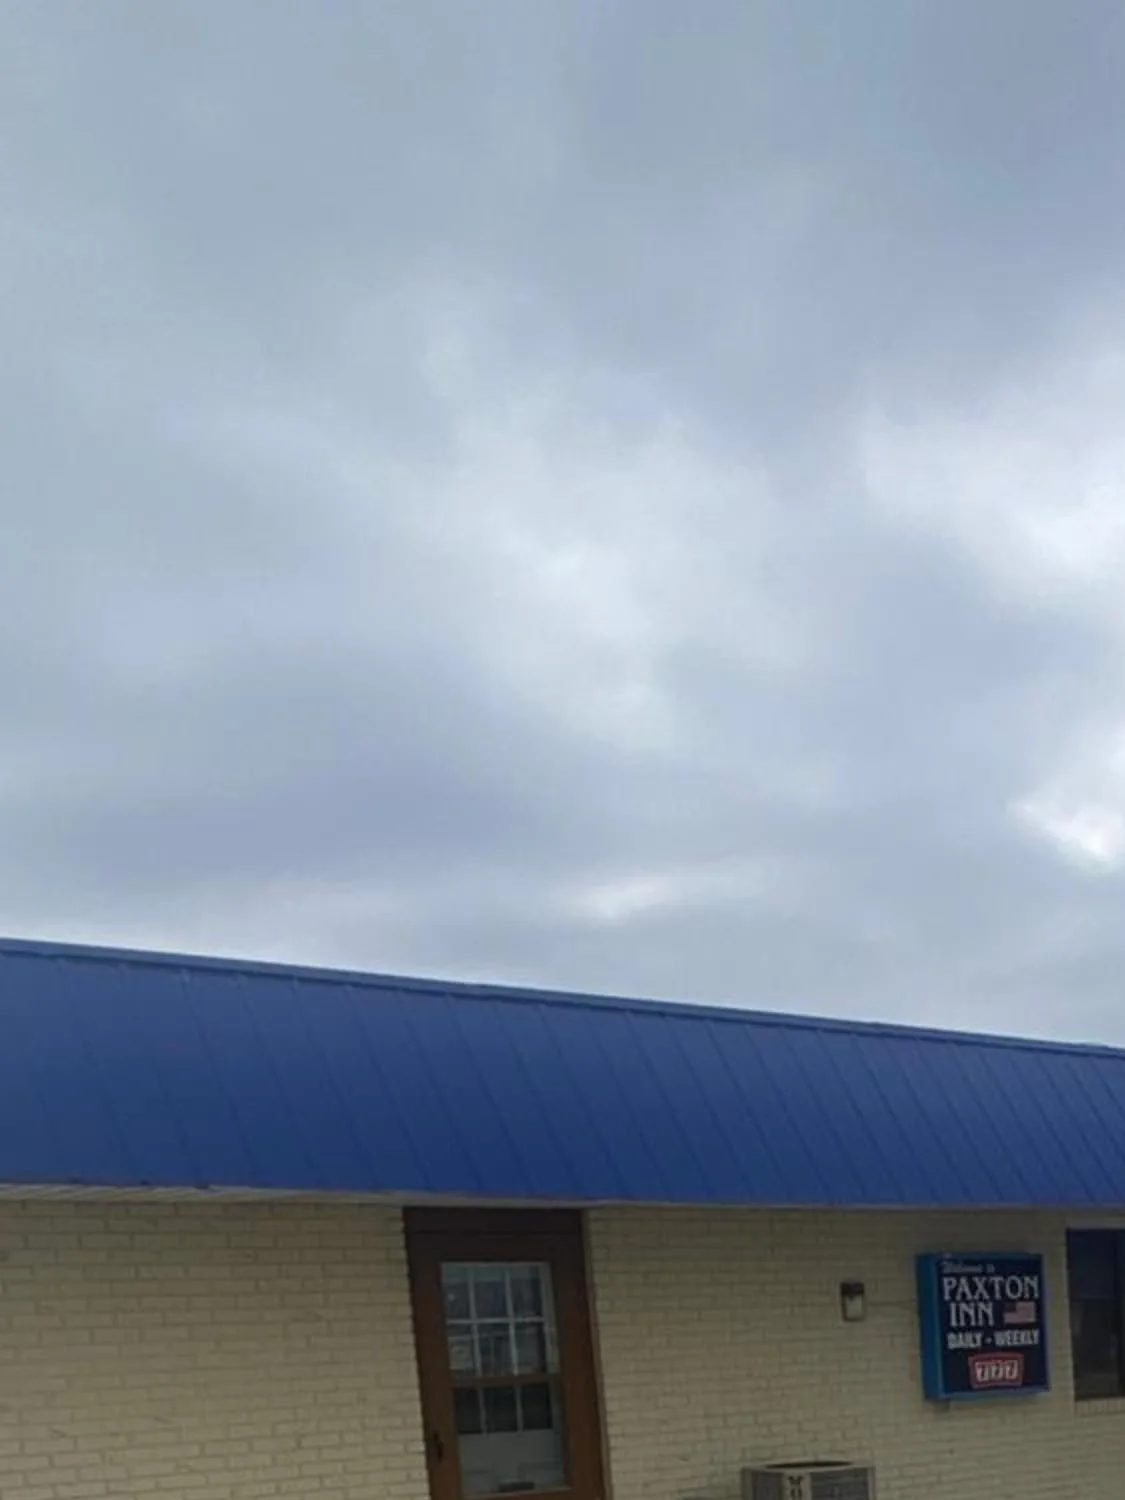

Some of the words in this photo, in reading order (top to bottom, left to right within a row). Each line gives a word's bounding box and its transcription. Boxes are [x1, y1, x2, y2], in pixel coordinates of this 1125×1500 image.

[942, 1275, 1039, 1301] PAXTON
[950, 1301, 995, 1327] INN
[947, 1331, 983, 1349] DAILY
[994, 1329, 1040, 1346] WEEKLY
